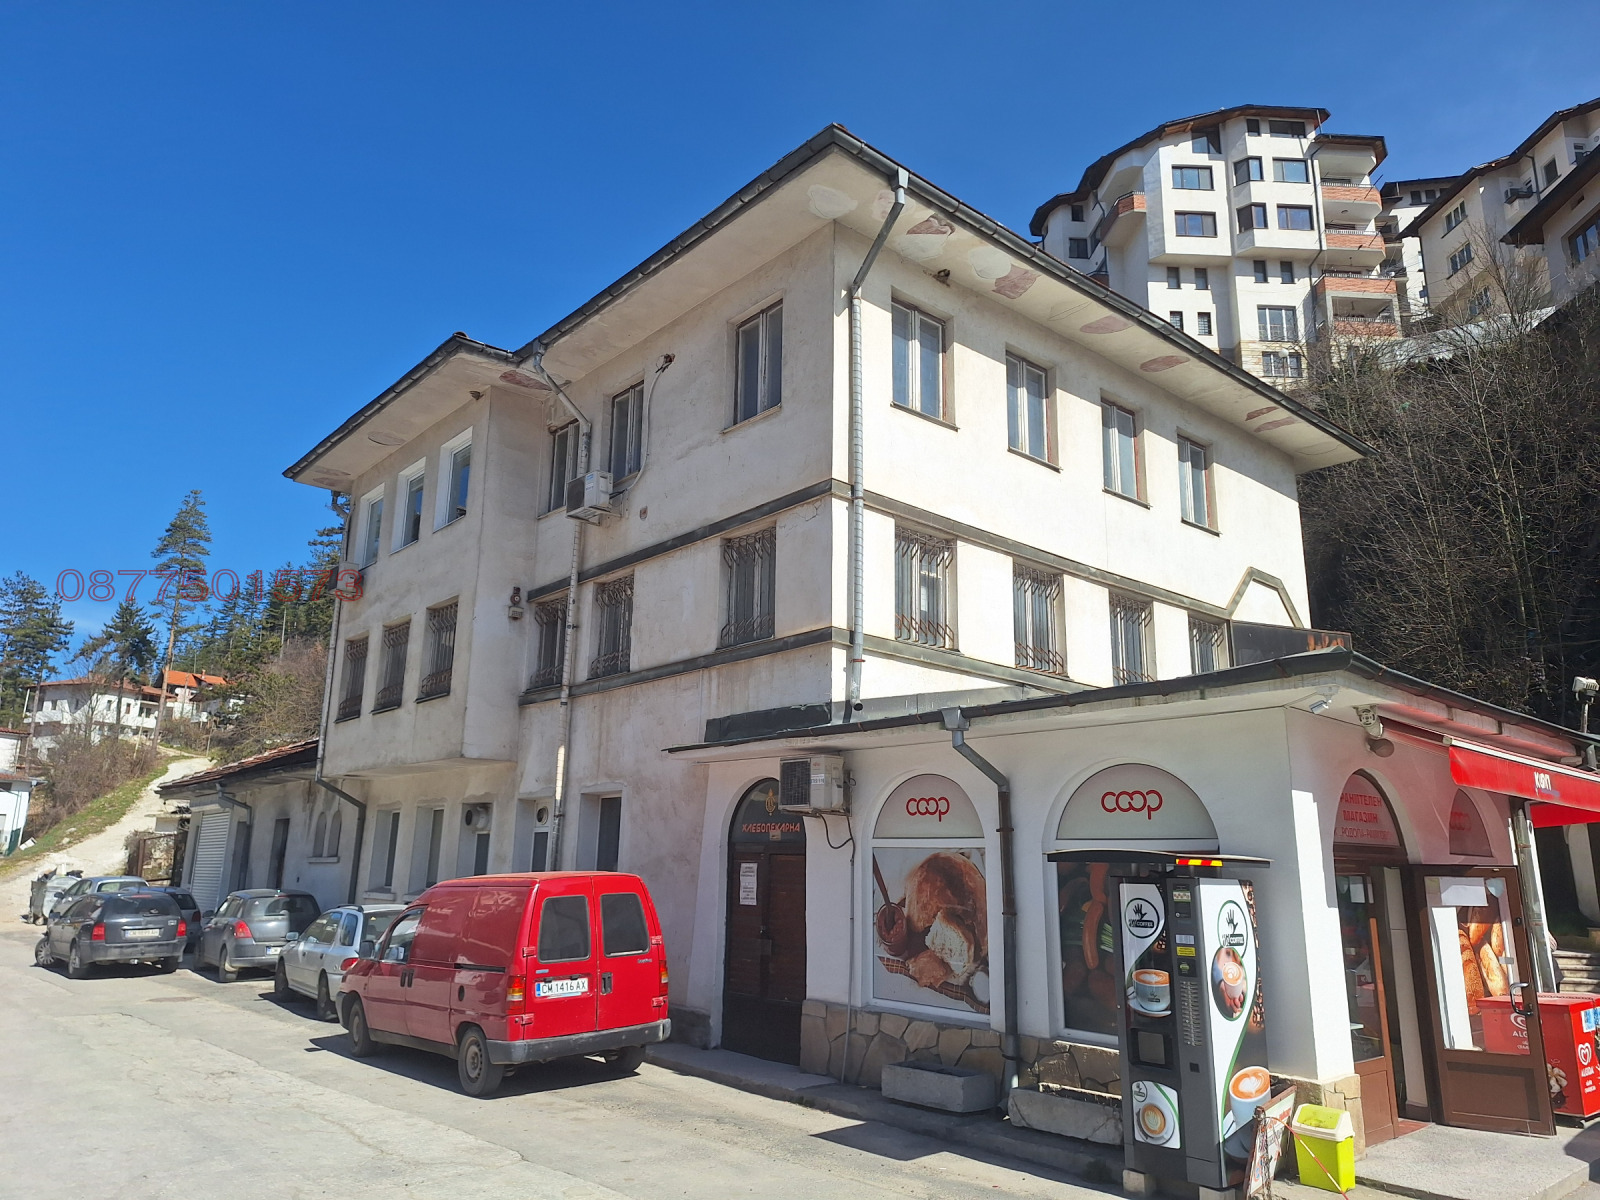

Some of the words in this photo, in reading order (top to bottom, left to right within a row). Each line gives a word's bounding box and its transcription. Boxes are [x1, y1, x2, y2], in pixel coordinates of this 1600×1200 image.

[1101, 789, 1163, 820] coop
[1340, 792, 1383, 807] РАНИТЕЛЕН
[906, 796, 950, 822] coop
[1343, 809, 1378, 824] МАГАЗИН
[742, 822, 800, 833] ХЛЕБОПЕКАРНА
[541, 983, 554, 994] CM
[556, 981, 575, 993] 1416
[576, 980, 586, 991] AX
